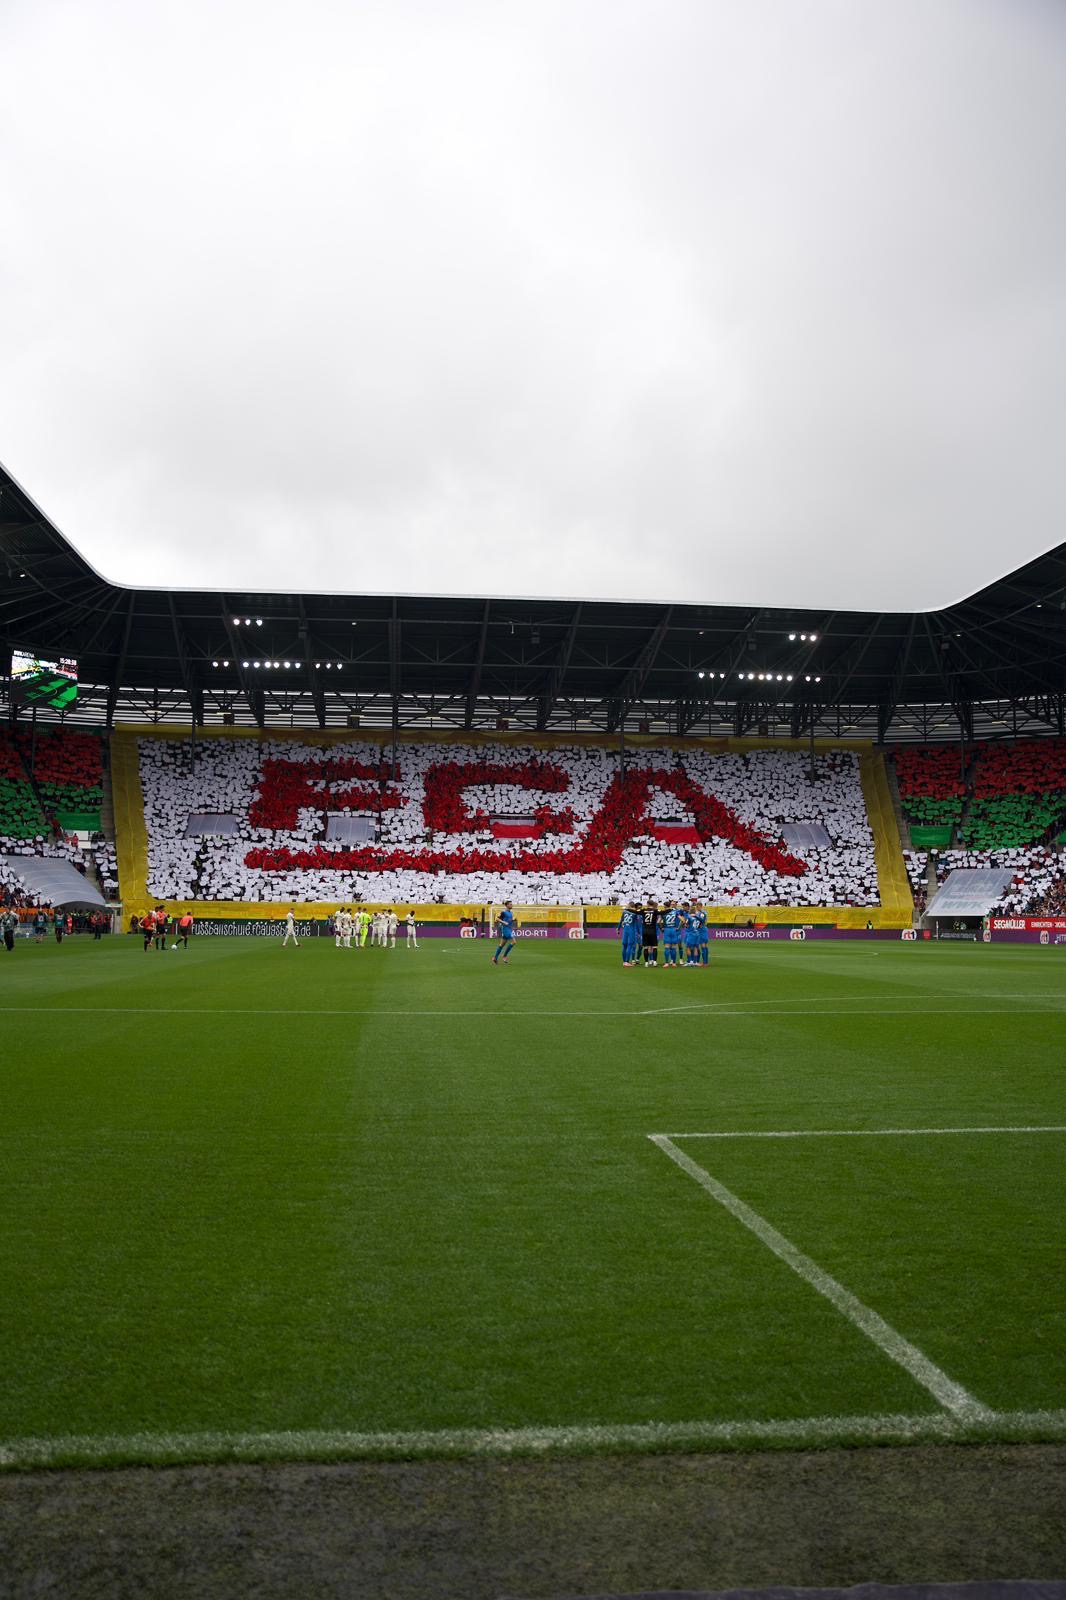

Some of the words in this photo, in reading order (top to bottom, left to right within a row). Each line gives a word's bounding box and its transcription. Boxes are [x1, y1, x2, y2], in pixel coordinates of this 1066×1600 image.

[246, 757, 808, 876] FCA
[623, 913, 633, 924] 26
[644, 912, 653, 923] 21
[665, 914, 676, 925] 22
[715, 930, 754, 938] HITRADIO
